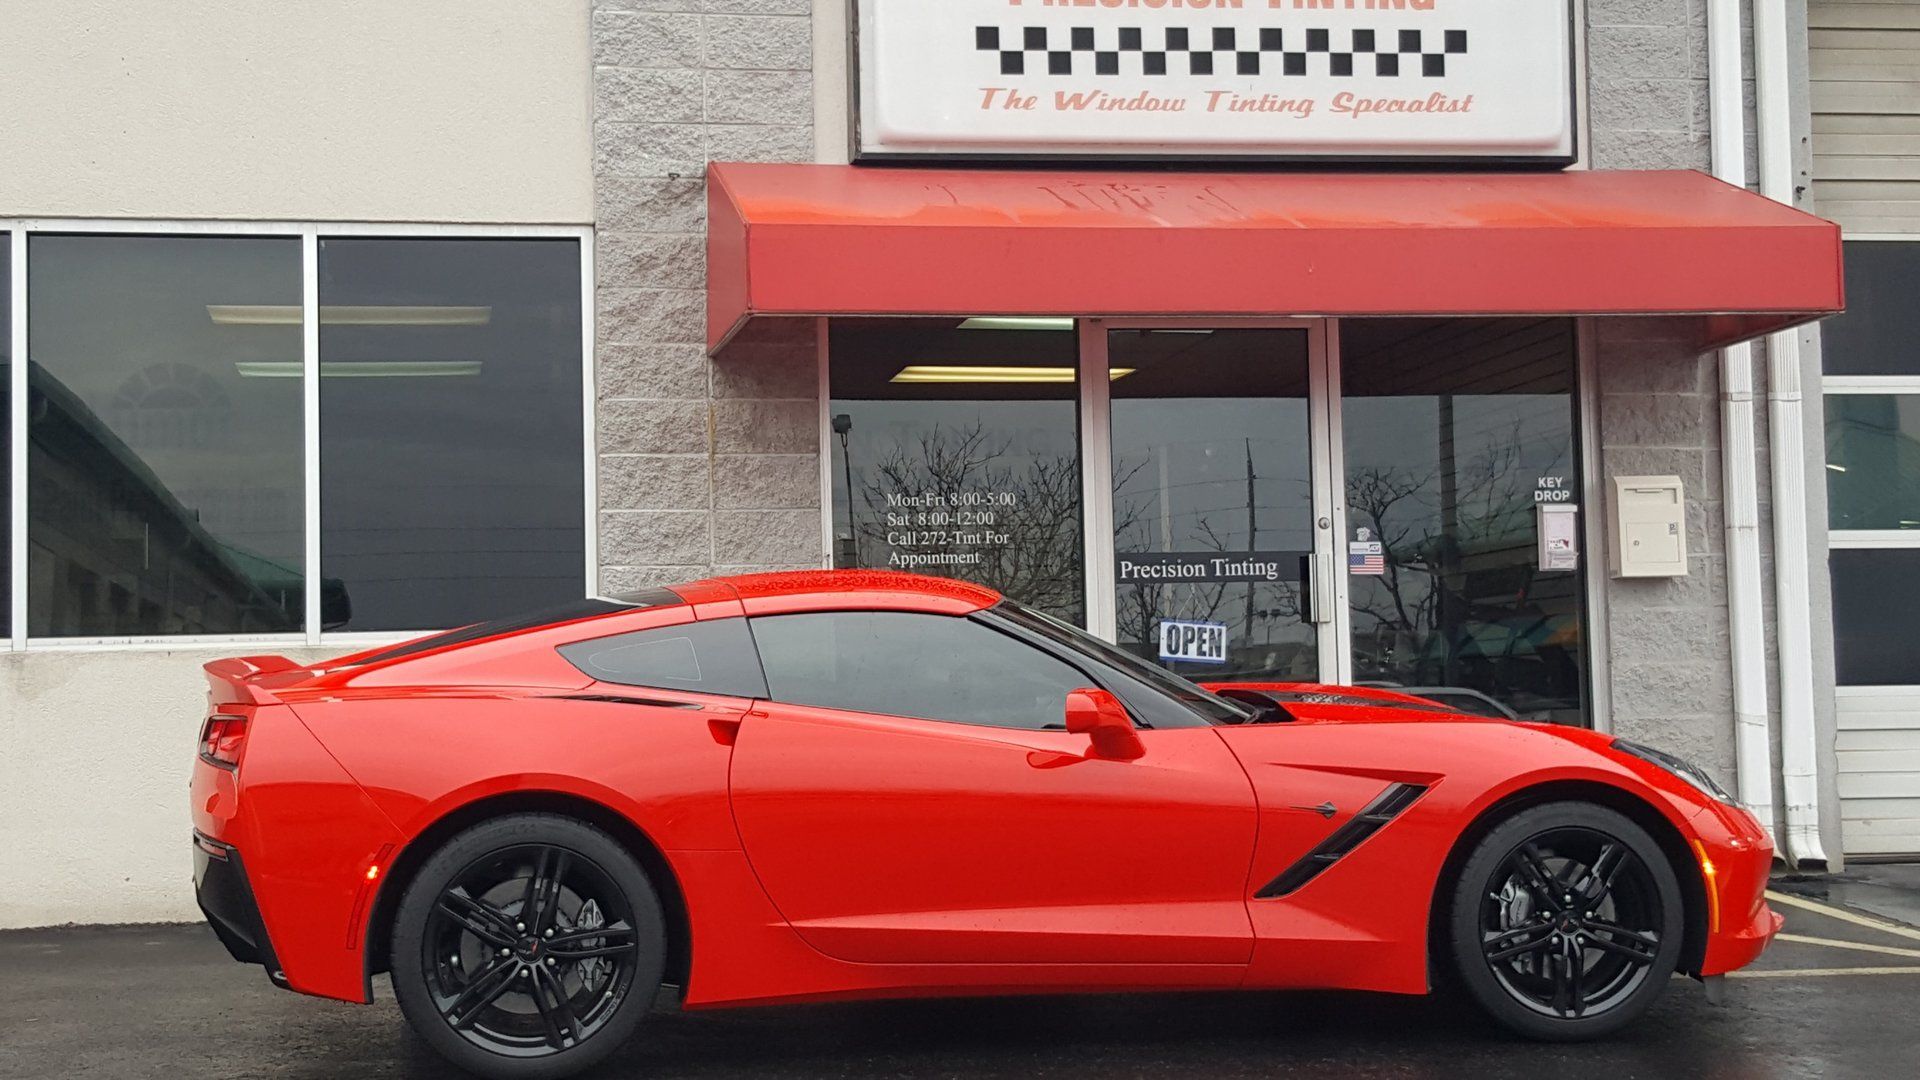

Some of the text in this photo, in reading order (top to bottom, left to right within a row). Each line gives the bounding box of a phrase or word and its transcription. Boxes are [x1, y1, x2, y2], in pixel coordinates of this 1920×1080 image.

[979, 87, 1474, 119] The Window Tinting Specialist
[1538, 477, 1563, 488] KEY
[887, 492, 1016, 507] Mon-Fri 8:00-5:00
[1534, 490, 1570, 502] DROP
[887, 511, 994, 526] Sat 8:00-12:00
[887, 530, 1010, 546] Call 272-Tint For
[888, 550, 981, 568] Appointment
[1120, 557, 1279, 580] Precision Tinting
[1166, 624, 1222, 658] OPEN
